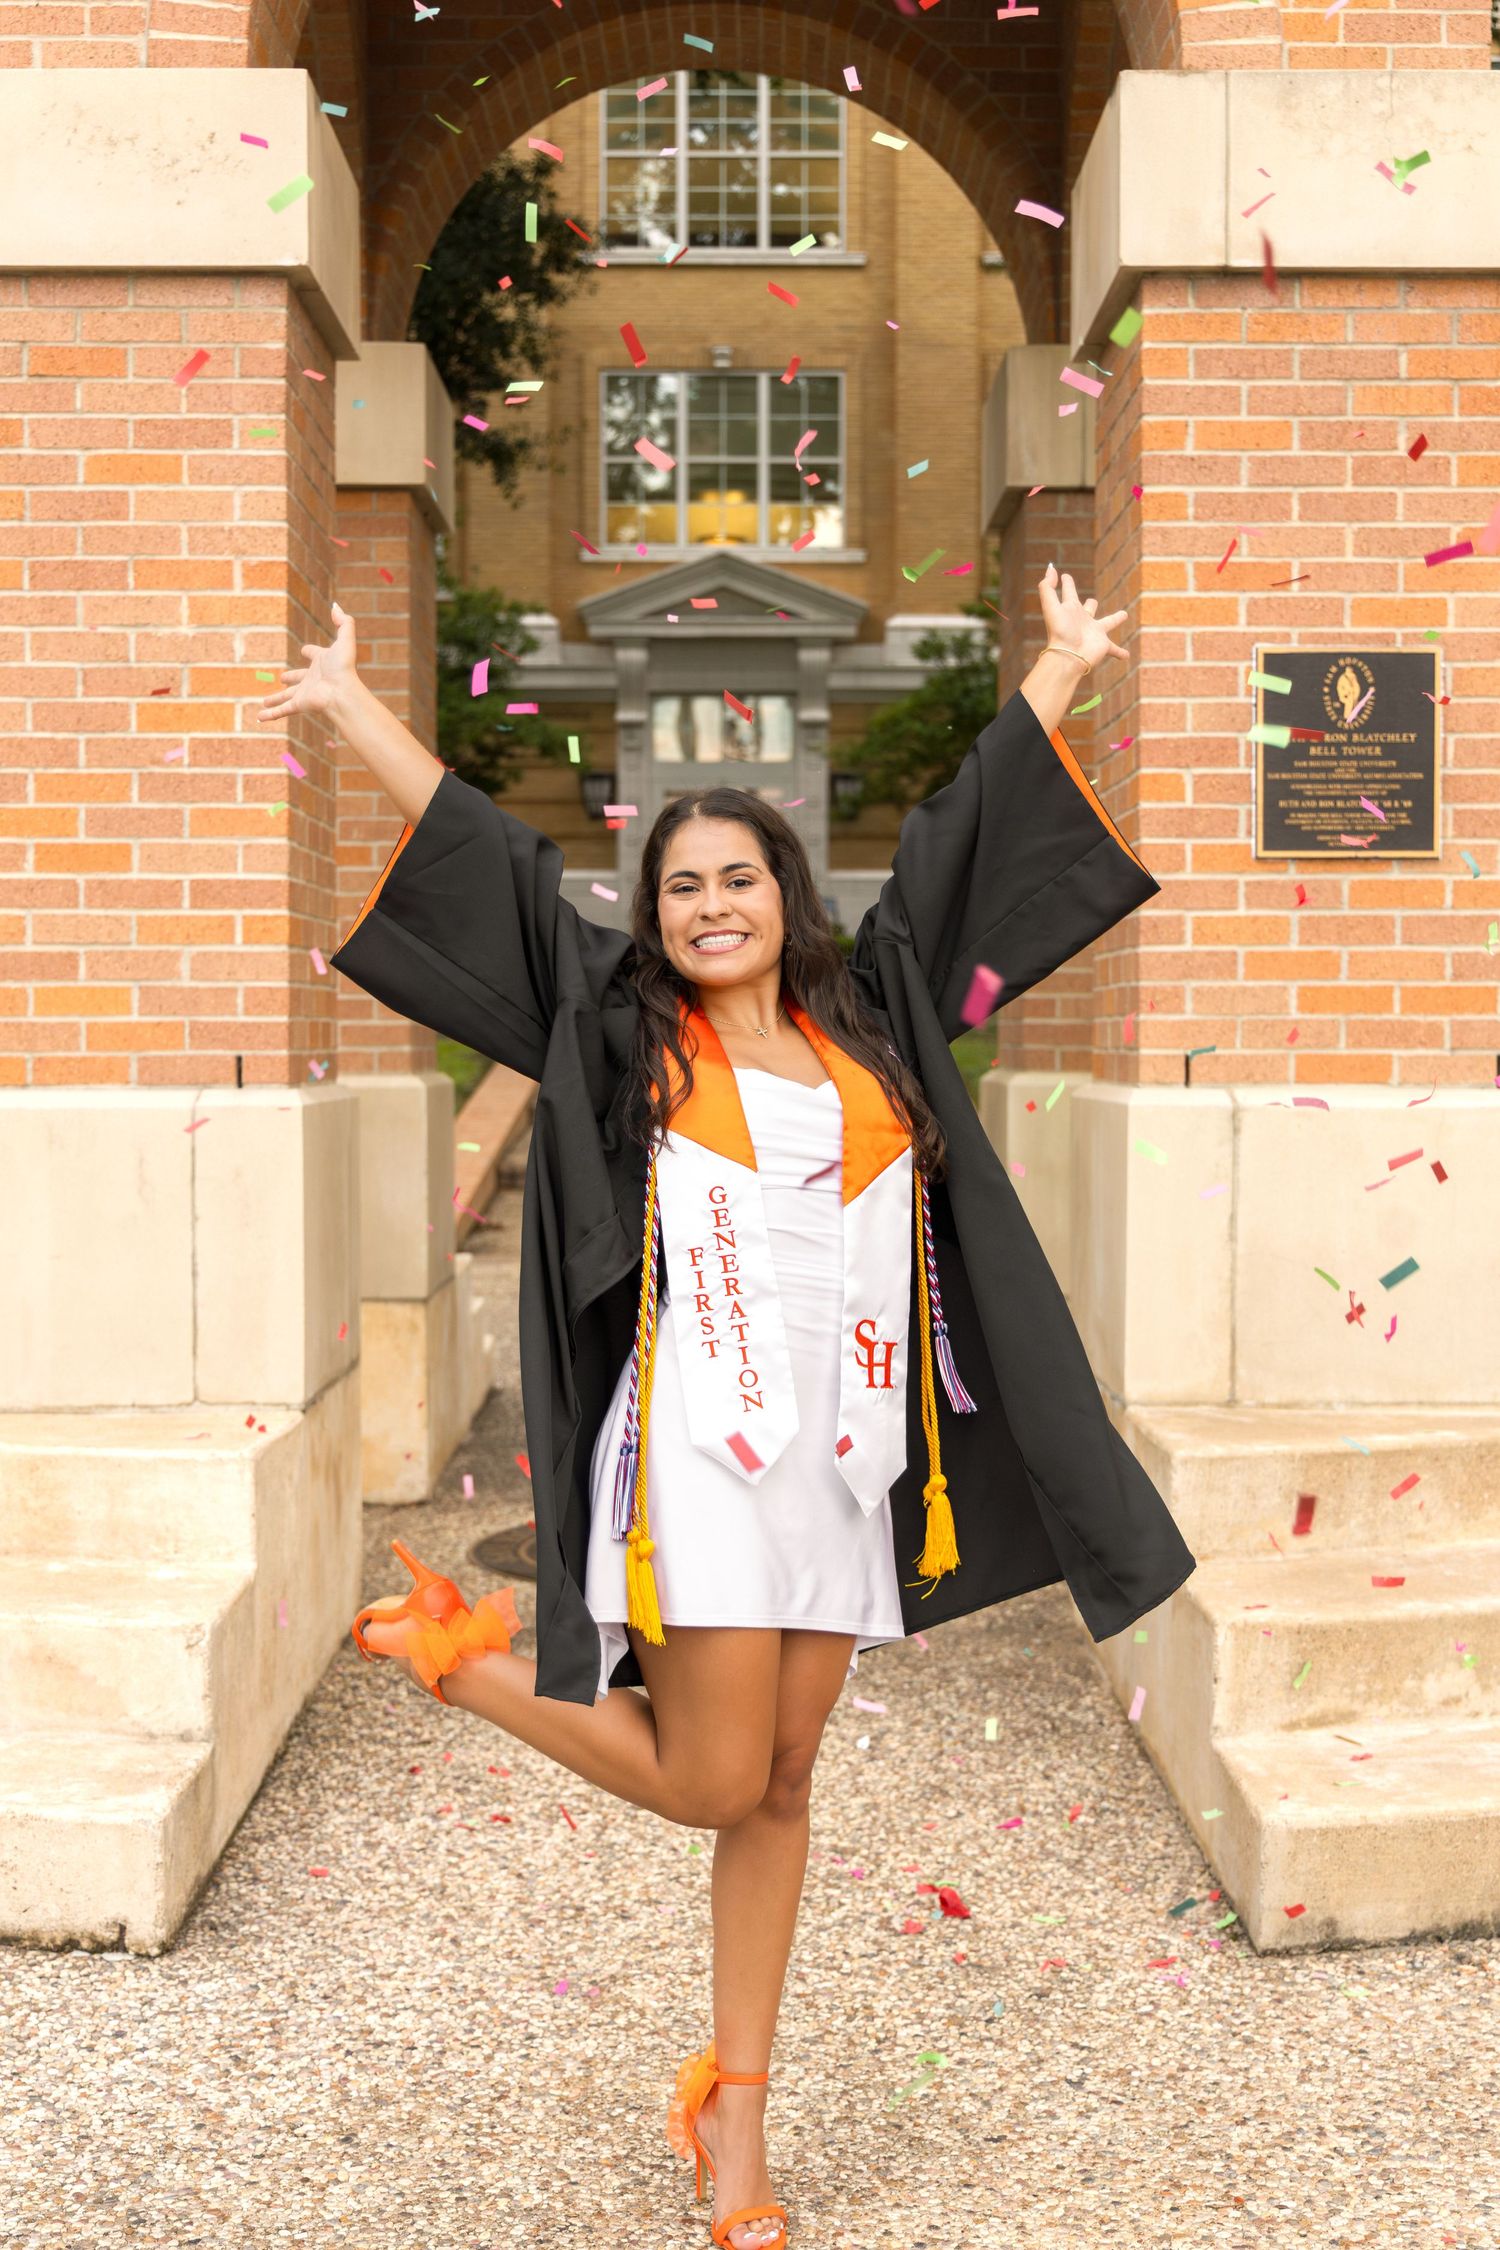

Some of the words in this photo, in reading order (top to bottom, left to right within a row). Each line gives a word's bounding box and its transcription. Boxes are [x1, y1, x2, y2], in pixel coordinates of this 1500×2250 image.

[1323, 665, 1338, 684] SAM
[1338, 657, 1374, 683] HOUSTON
[1309, 746, 1337, 756] BELL
[1342, 746, 1382, 756] TOWER
[1324, 733, 1348, 743] RON
[1352, 733, 1417, 743] BLATCHLEY
[687, 1247, 721, 1359] FIRST
[708, 1186, 764, 1413] GENERATION
[854, 1319, 898, 1389] SH
